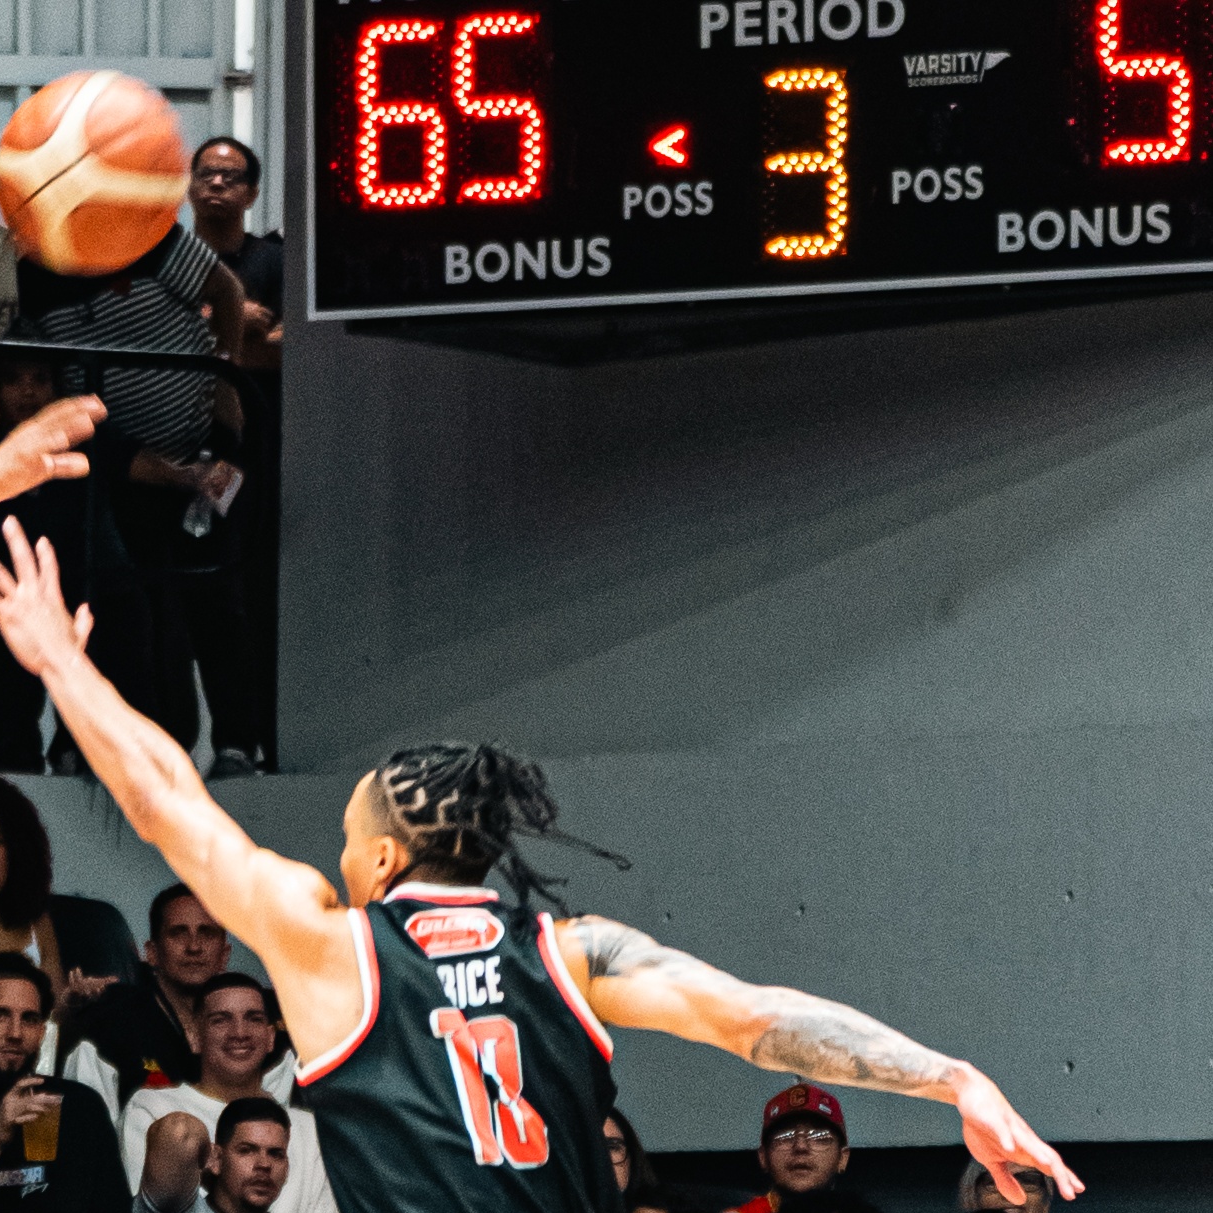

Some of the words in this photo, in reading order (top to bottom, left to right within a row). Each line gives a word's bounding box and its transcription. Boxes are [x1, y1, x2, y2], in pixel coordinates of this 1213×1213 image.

[699, 0, 906, 48] PERIOD
[903, 51, 982, 76] VARSITY
[355, 12, 544, 210] 65
[763, 65, 849, 258] 3
[890, 165, 985, 204] POSS
[623, 182, 715, 219] POSS
[996, 203, 1173, 254] BONUS
[444, 237, 613, 285] BONUS
